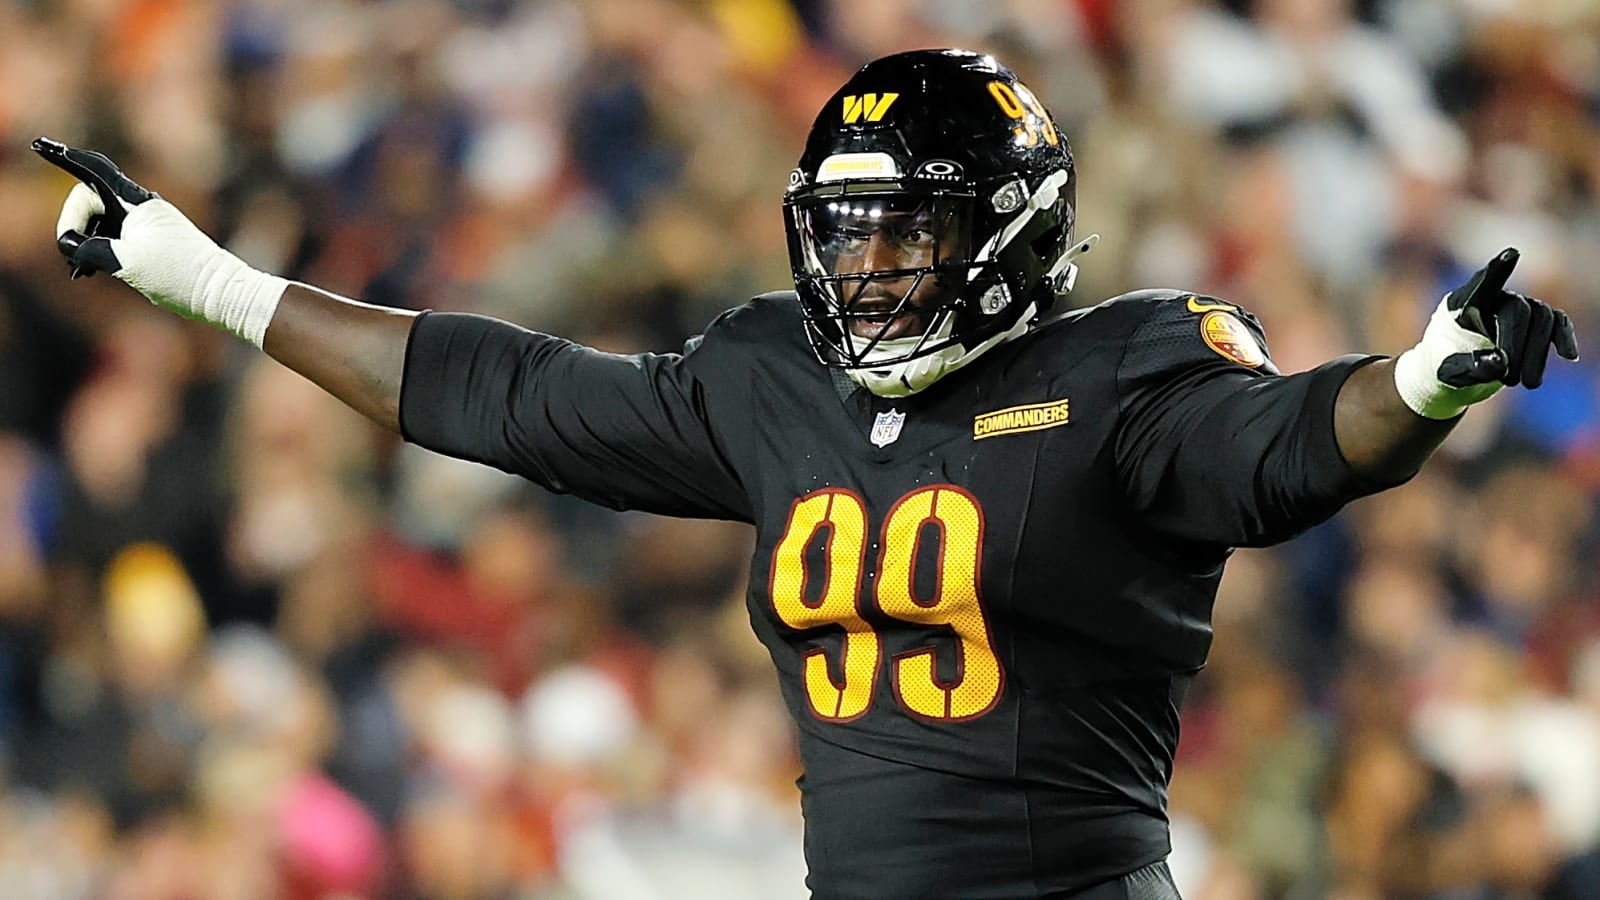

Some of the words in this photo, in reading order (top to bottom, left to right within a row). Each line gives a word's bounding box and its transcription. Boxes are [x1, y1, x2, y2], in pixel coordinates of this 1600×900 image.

[843, 93, 899, 124] W
[989, 81, 1059, 147] 99
[875, 425, 895, 439] NFL
[974, 404, 1069, 434] COMMANDERS
[768, 484, 1006, 723] 99
